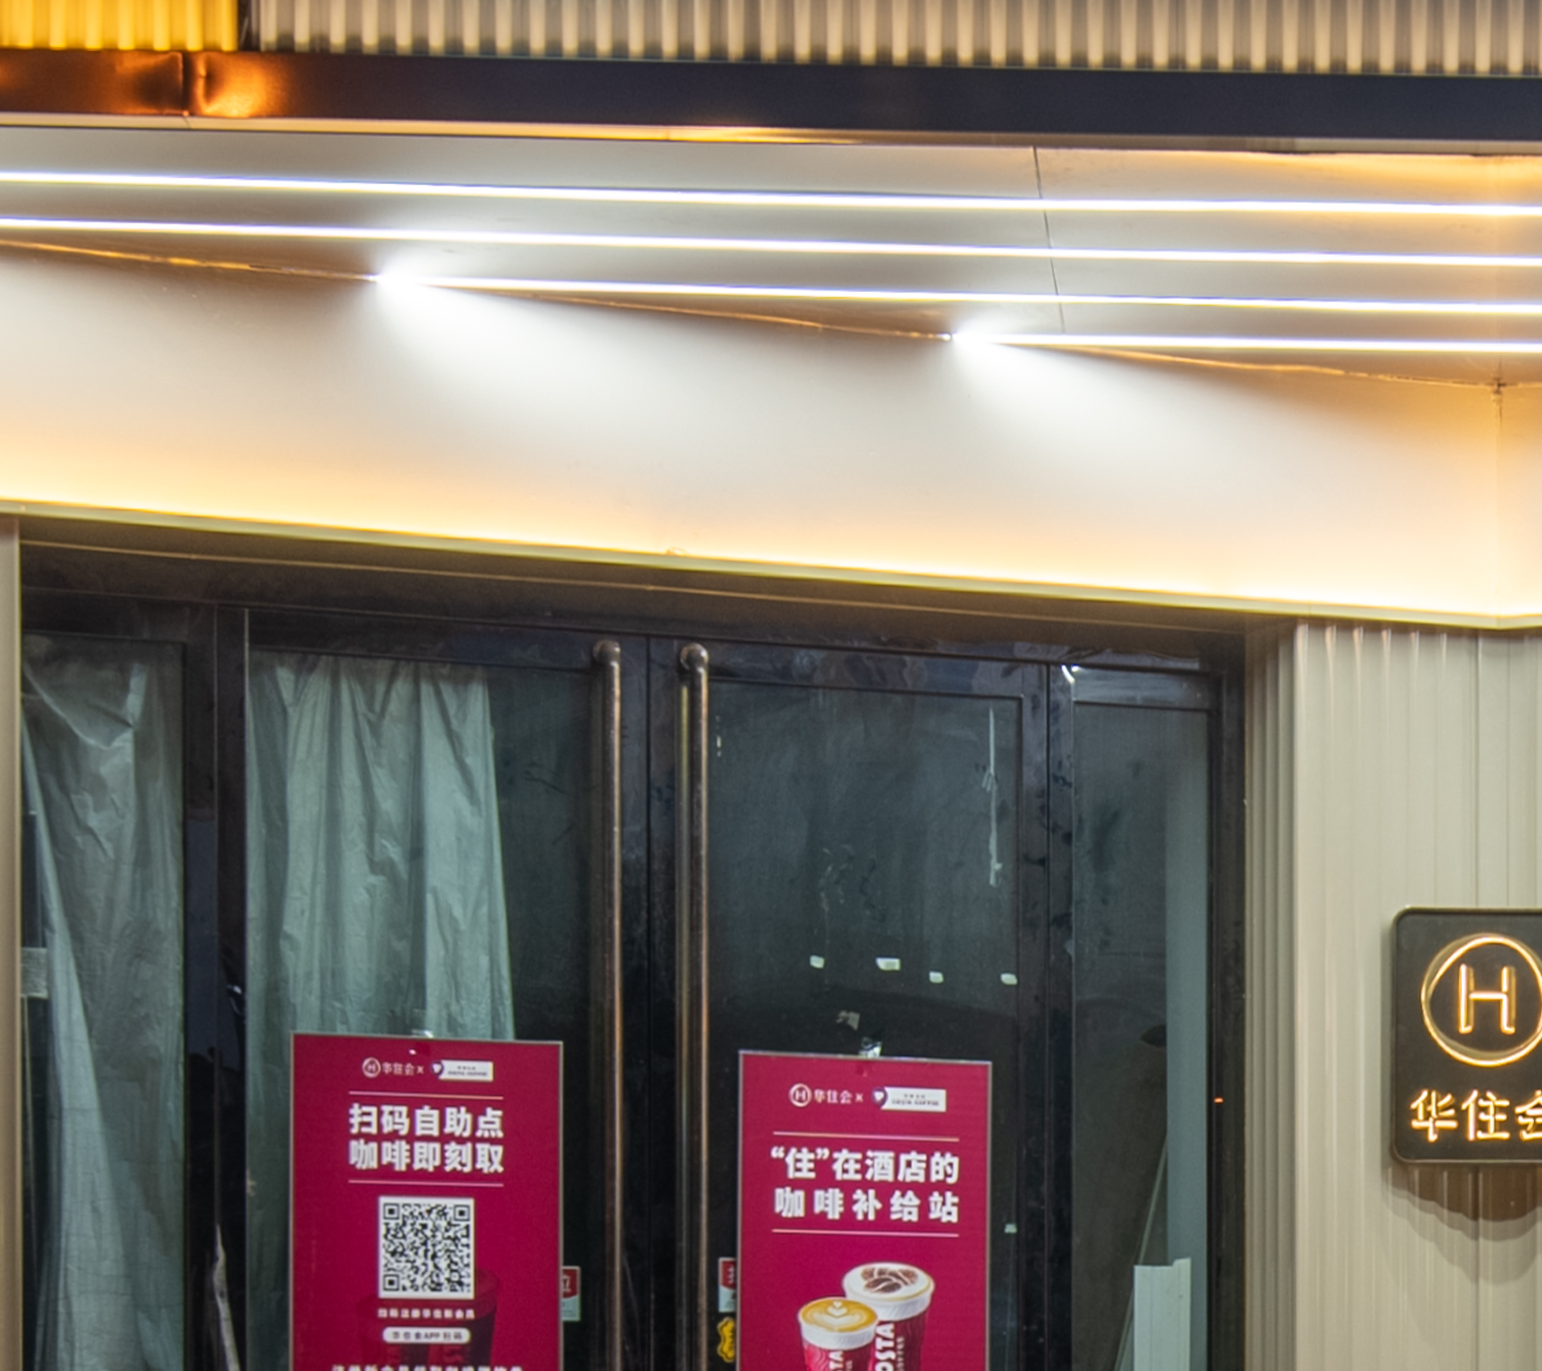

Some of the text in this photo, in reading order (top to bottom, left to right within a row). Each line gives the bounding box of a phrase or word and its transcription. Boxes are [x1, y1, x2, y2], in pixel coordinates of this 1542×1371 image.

[348, 1103, 505, 1138] 扫码自助点
[348, 1139, 505, 1173] 咖啡即刻取
[774, 1187, 960, 1223] 咖啡补给站
